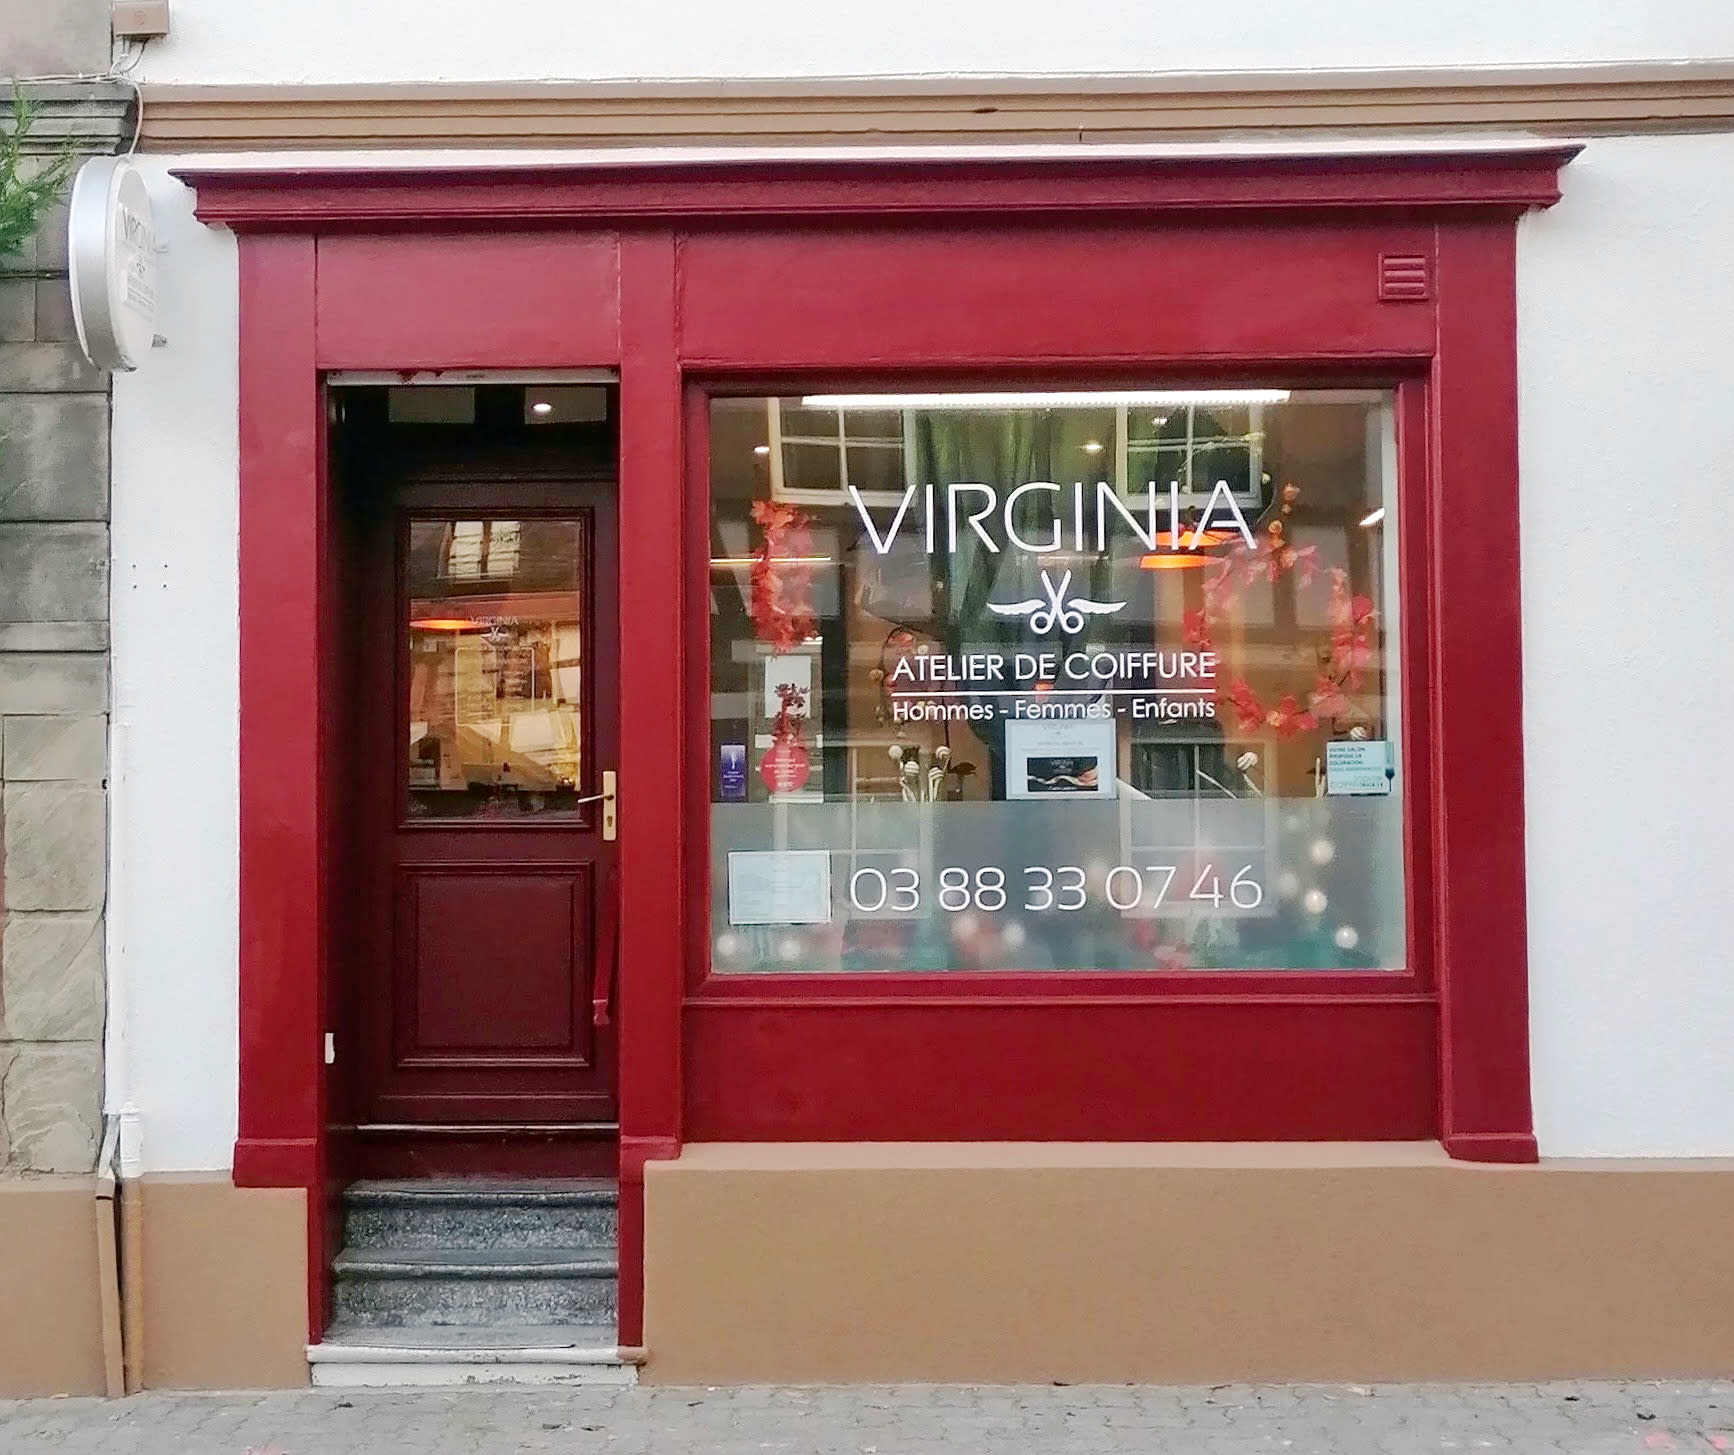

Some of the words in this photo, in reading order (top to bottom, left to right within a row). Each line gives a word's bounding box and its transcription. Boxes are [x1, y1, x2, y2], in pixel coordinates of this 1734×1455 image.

[849, 480, 1257, 554] VIRGINIA
[893, 653, 1004, 681] ATELIER
[1015, 652, 1055, 680] DE
[1064, 651, 1216, 679] COIFFURE
[893, 701, 994, 721] Hommes
[1015, 700, 1111, 720] Femmes
[1133, 699, 1215, 719] Enfants
[850, 867, 920, 912] 03
[939, 866, 1007, 911] 88
[1024, 866, 1088, 911] 33
[1105, 866, 1177, 910] 07
[1189, 864, 1263, 909] 46
